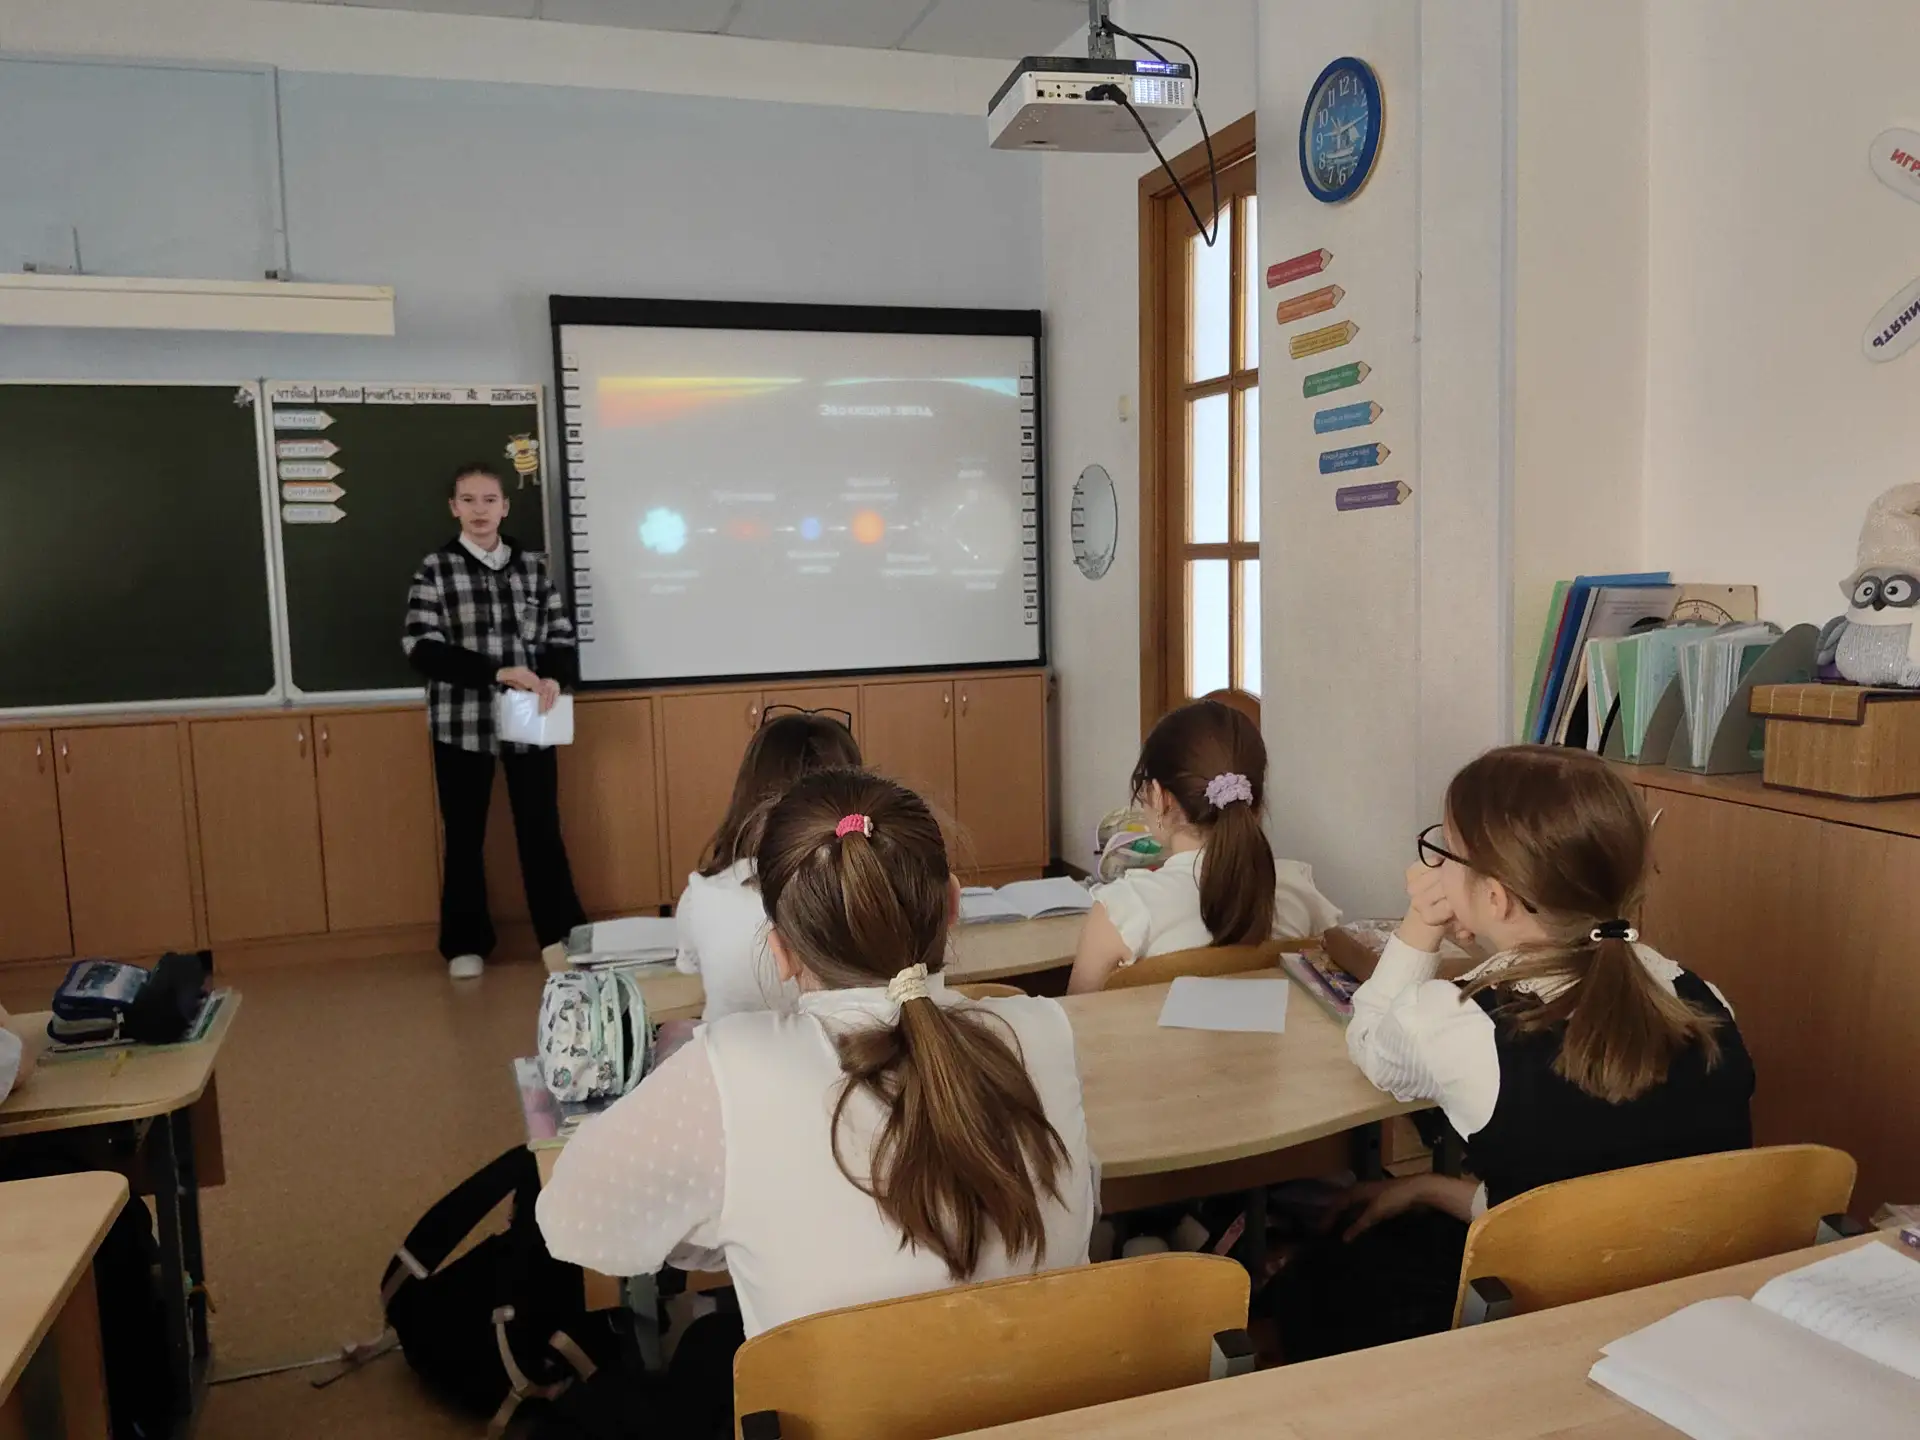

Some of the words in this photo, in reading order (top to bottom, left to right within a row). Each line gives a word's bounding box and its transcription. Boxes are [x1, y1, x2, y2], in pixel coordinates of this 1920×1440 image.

[1339, 75, 1350, 97] 12
[1352, 77, 1359, 96] 1
[1327, 87, 1336, 108] 11
[1318, 107, 1329, 129] 10
[1316, 133, 1324, 150] 9
[1318, 152, 1326, 170] 8
[1890, 148, 1920, 176] ИГР
[1327, 165, 1335, 184] 7
[1338, 166, 1348, 186] 6
[1872, 297, 1920, 347] ИНЯТЬ
